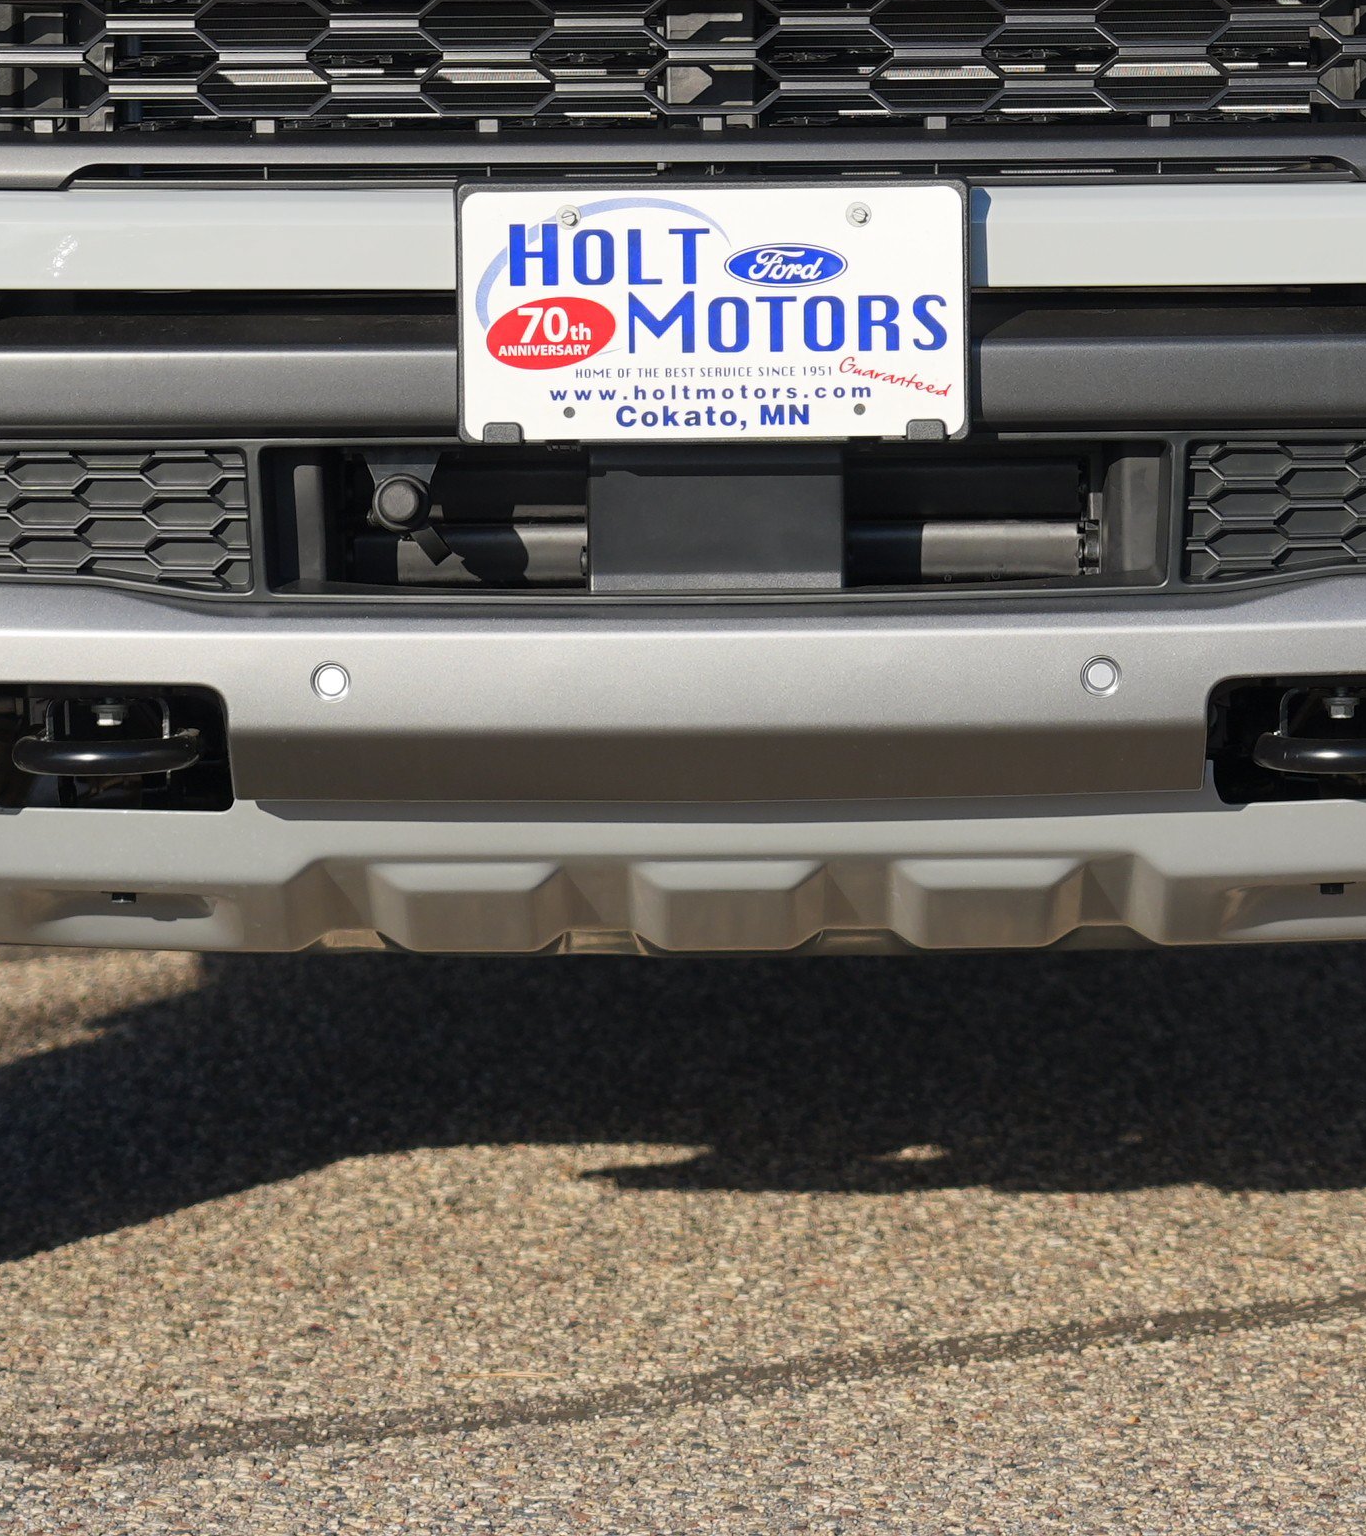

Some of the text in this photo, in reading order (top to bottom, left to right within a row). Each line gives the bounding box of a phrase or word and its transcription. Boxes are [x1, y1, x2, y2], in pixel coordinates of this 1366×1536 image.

[509, 223, 710, 286] HOLT
[748, 248, 824, 281] Ford
[517, 306, 592, 344] 70th
[628, 290, 948, 354] MOTORS
[498, 344, 591, 357] ANNIVERSARY
[575, 366, 833, 379] HOME OF THE BEST SERVICE SINCE 1951
[839, 356, 952, 397] Guaranteed
[549, 384, 872, 401] www.holtmotors.com
[615, 404, 810, 430] Cokato, MN
